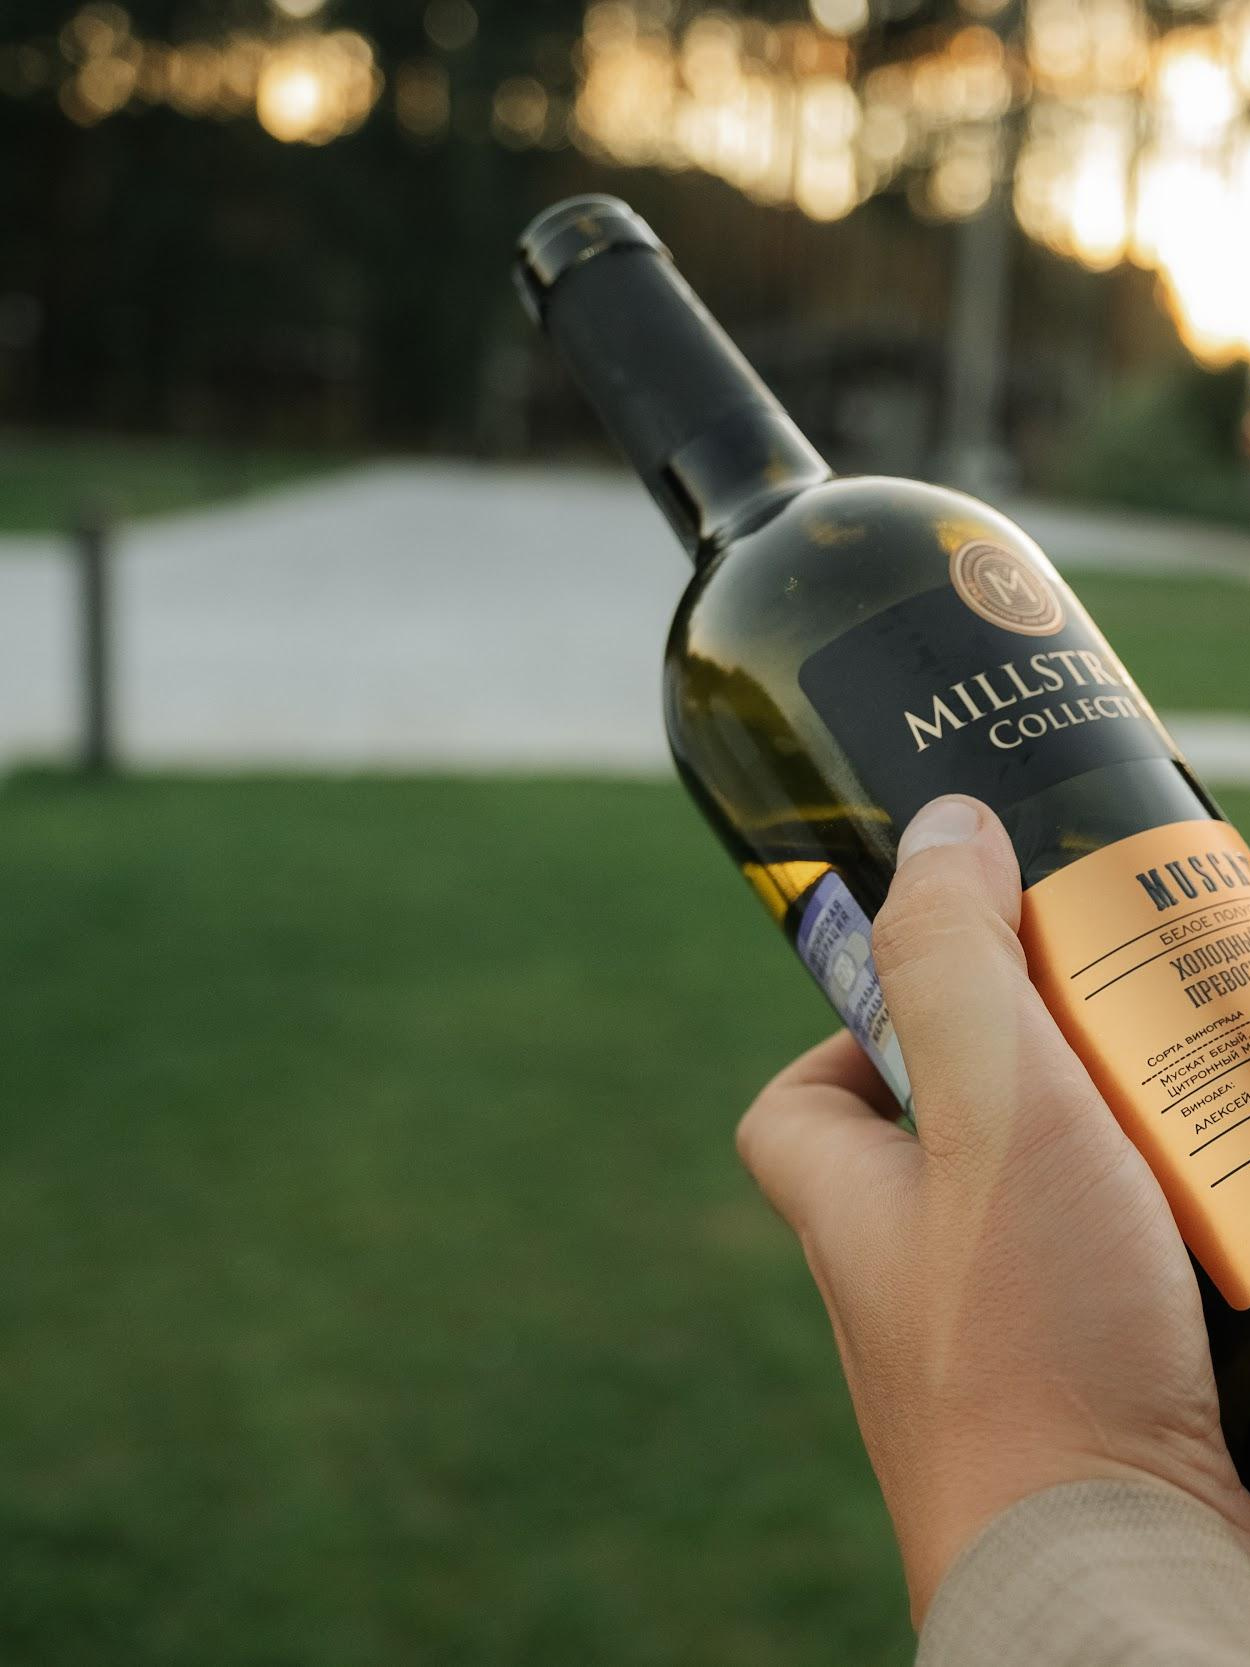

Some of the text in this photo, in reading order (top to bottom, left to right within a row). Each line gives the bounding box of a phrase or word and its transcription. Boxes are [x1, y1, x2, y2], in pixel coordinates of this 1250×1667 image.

[903, 650, 1128, 752] MILLSTR
[988, 695, 1141, 750] COLLECTI
[1159, 916, 1213, 946] БЕЛОЕ
[1167, 1051, 1240, 1098] ЦИТРОННЫЙ
